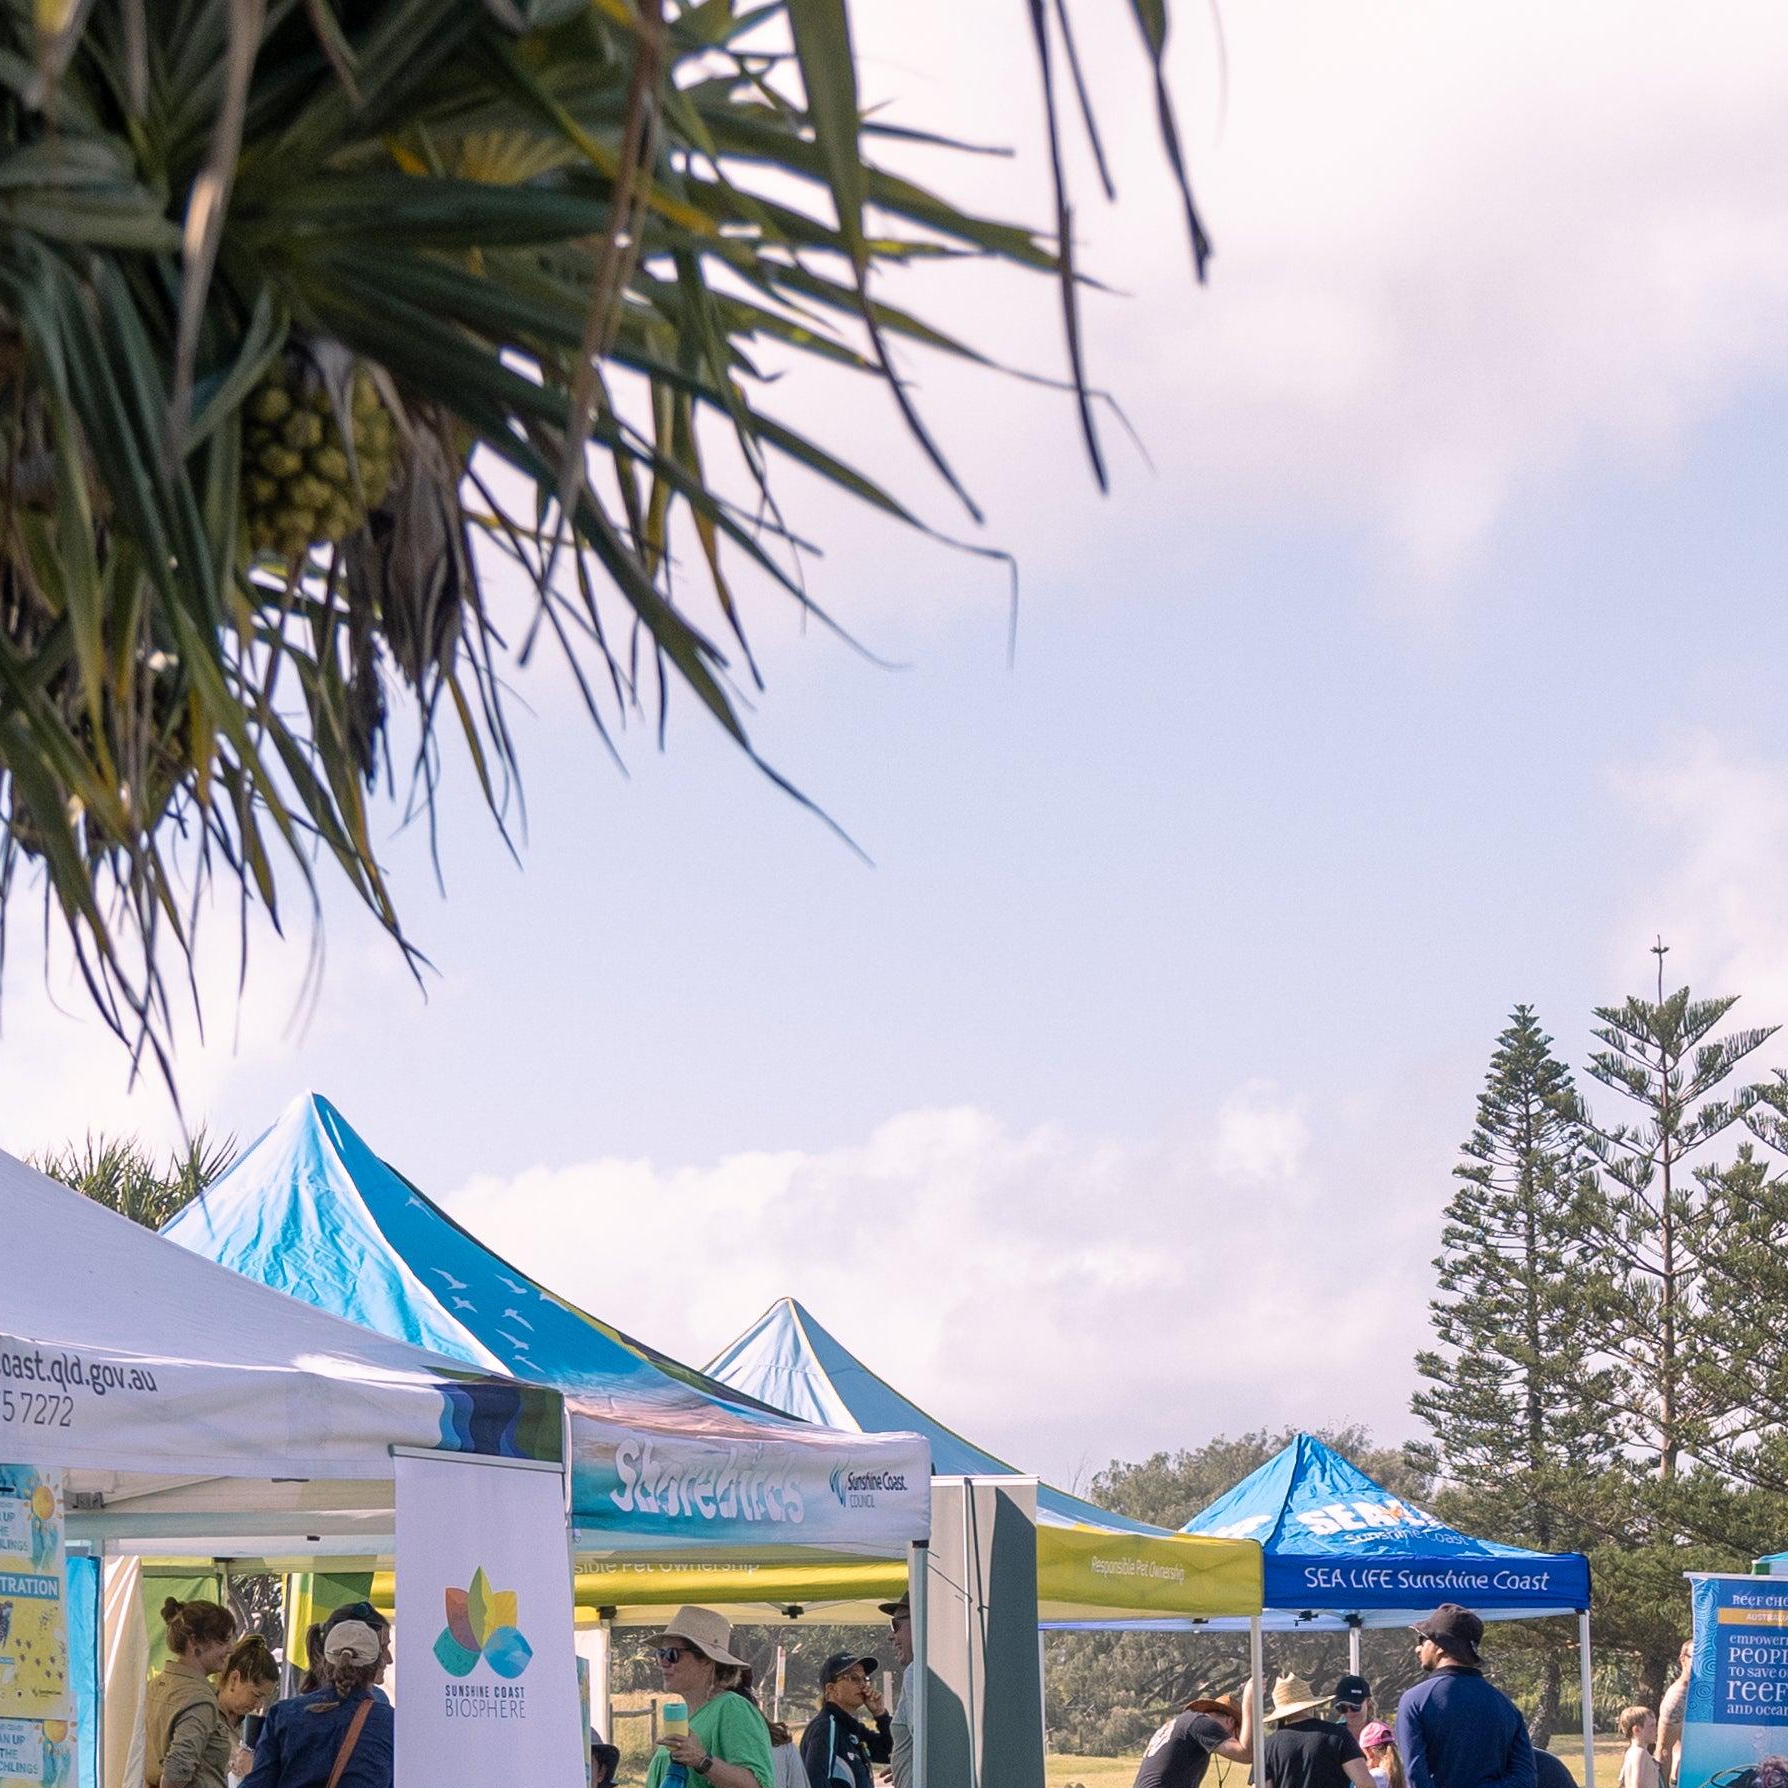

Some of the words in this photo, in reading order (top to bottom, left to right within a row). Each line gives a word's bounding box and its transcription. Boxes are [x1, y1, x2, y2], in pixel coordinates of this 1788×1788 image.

[20, 1393, 74, 1427] 7272
[847, 1471, 882, 1491] Sunshine
[882, 1472, 908, 1491] Coast
[2, 1512, 15, 1522] UP
[1092, 1555, 1135, 1579] Responsible
[1136, 1559, 1149, 1577] Pet
[1304, 1567, 1344, 1589] SEA
[1350, 1569, 1393, 1589] LIFE
[1397, 1570, 1489, 1590] Sunshine
[1494, 1571, 1549, 1592] Coast
[445, 1684, 490, 1698] SUNSHINE
[494, 1686, 525, 1699] COAST
[445, 1698, 526, 1719] BIOSPHERE
[12, 1734, 26, 1745] UP
[0, 1748, 18, 1760] THE
